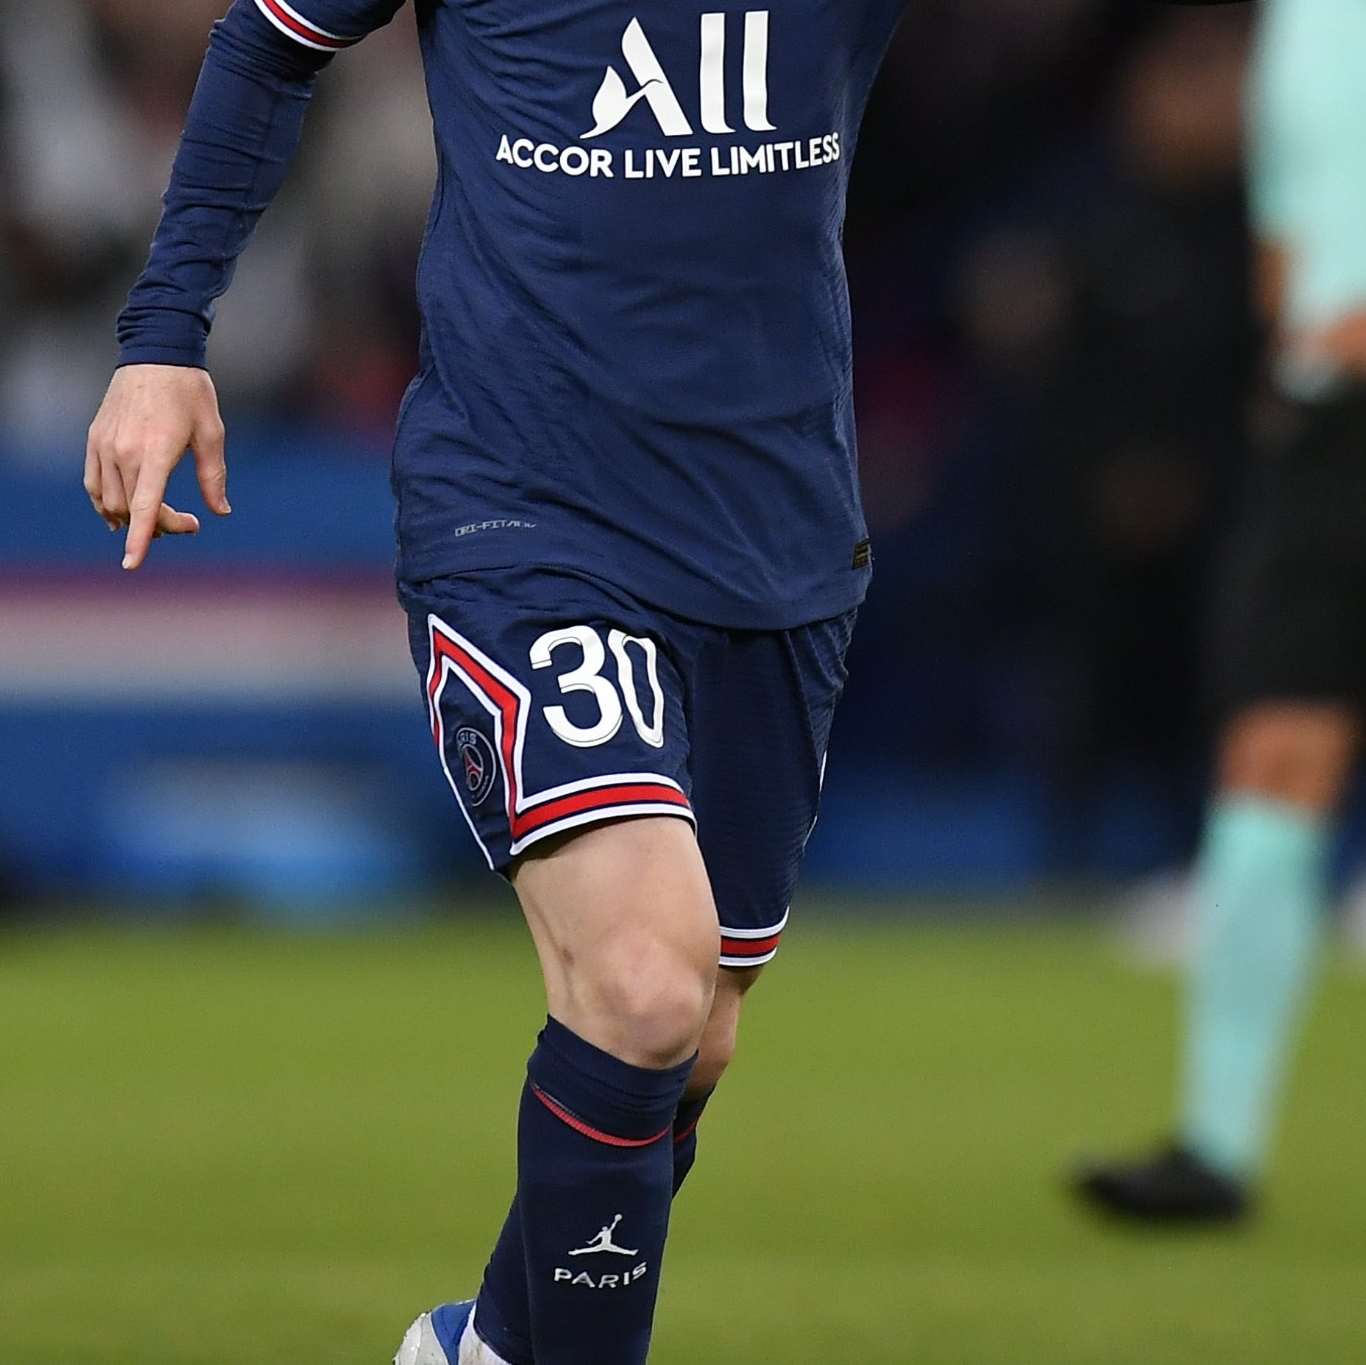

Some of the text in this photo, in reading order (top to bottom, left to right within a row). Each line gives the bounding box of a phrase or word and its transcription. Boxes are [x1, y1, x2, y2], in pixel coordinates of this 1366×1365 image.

[496, 132, 841, 179] ACCOR LIVE LIMITLESS
[529, 625, 664, 748] 30
[554, 1262, 647, 1289] PARIS
